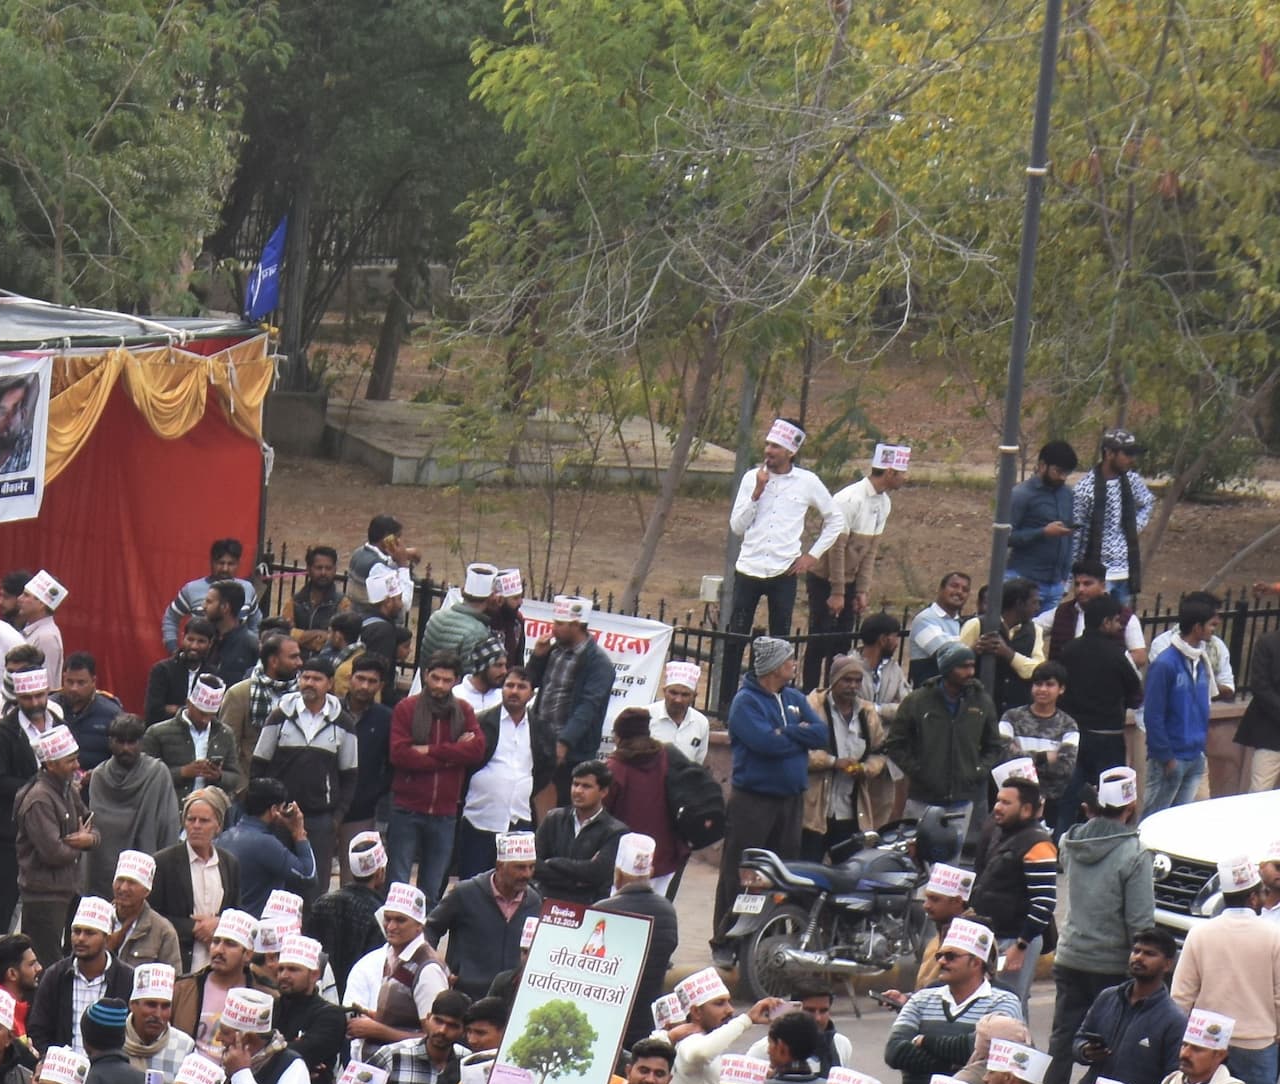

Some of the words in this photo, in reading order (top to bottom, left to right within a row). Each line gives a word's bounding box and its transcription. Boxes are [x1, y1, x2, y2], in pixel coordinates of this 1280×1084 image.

[1, 480, 28, 494] बीकानेर
[603, 632, 652, 655] धरना
[551, 905, 576, 918] दिनांक
[549, 946, 577, 967] जीव
[577, 955, 623, 976] बचाओं
[528, 971, 583, 996] पर्यावरण
[583, 983, 629, 1005] बचाओं
